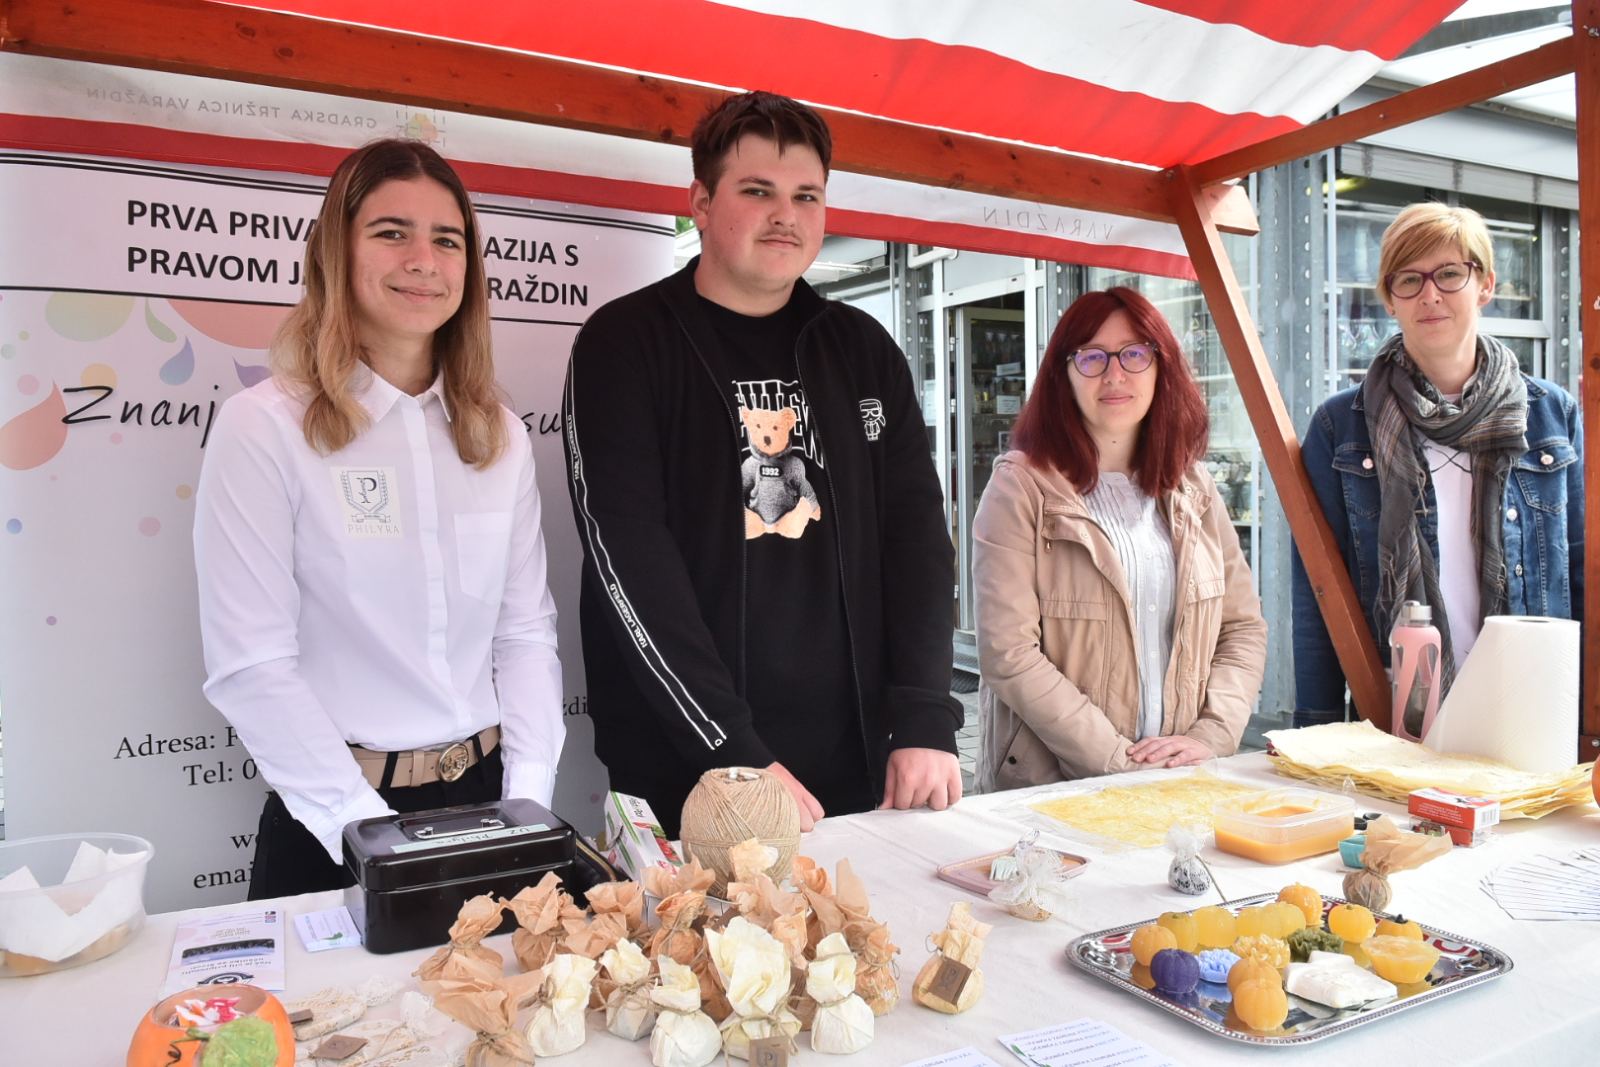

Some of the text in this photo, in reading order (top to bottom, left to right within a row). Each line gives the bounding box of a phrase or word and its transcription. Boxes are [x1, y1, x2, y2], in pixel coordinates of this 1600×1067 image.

[128, 200, 218, 234] PRVA
[483, 236, 557, 265] AZIJA
[564, 244, 579, 267] S
[128, 246, 588, 307] PRAVOM J RAŽDIN
[61, 385, 219, 449] Znanj
[634, 625, 648, 649] KARL
[114, 733, 215, 760] Adresa:
[183, 758, 258, 786] Tel: 0
